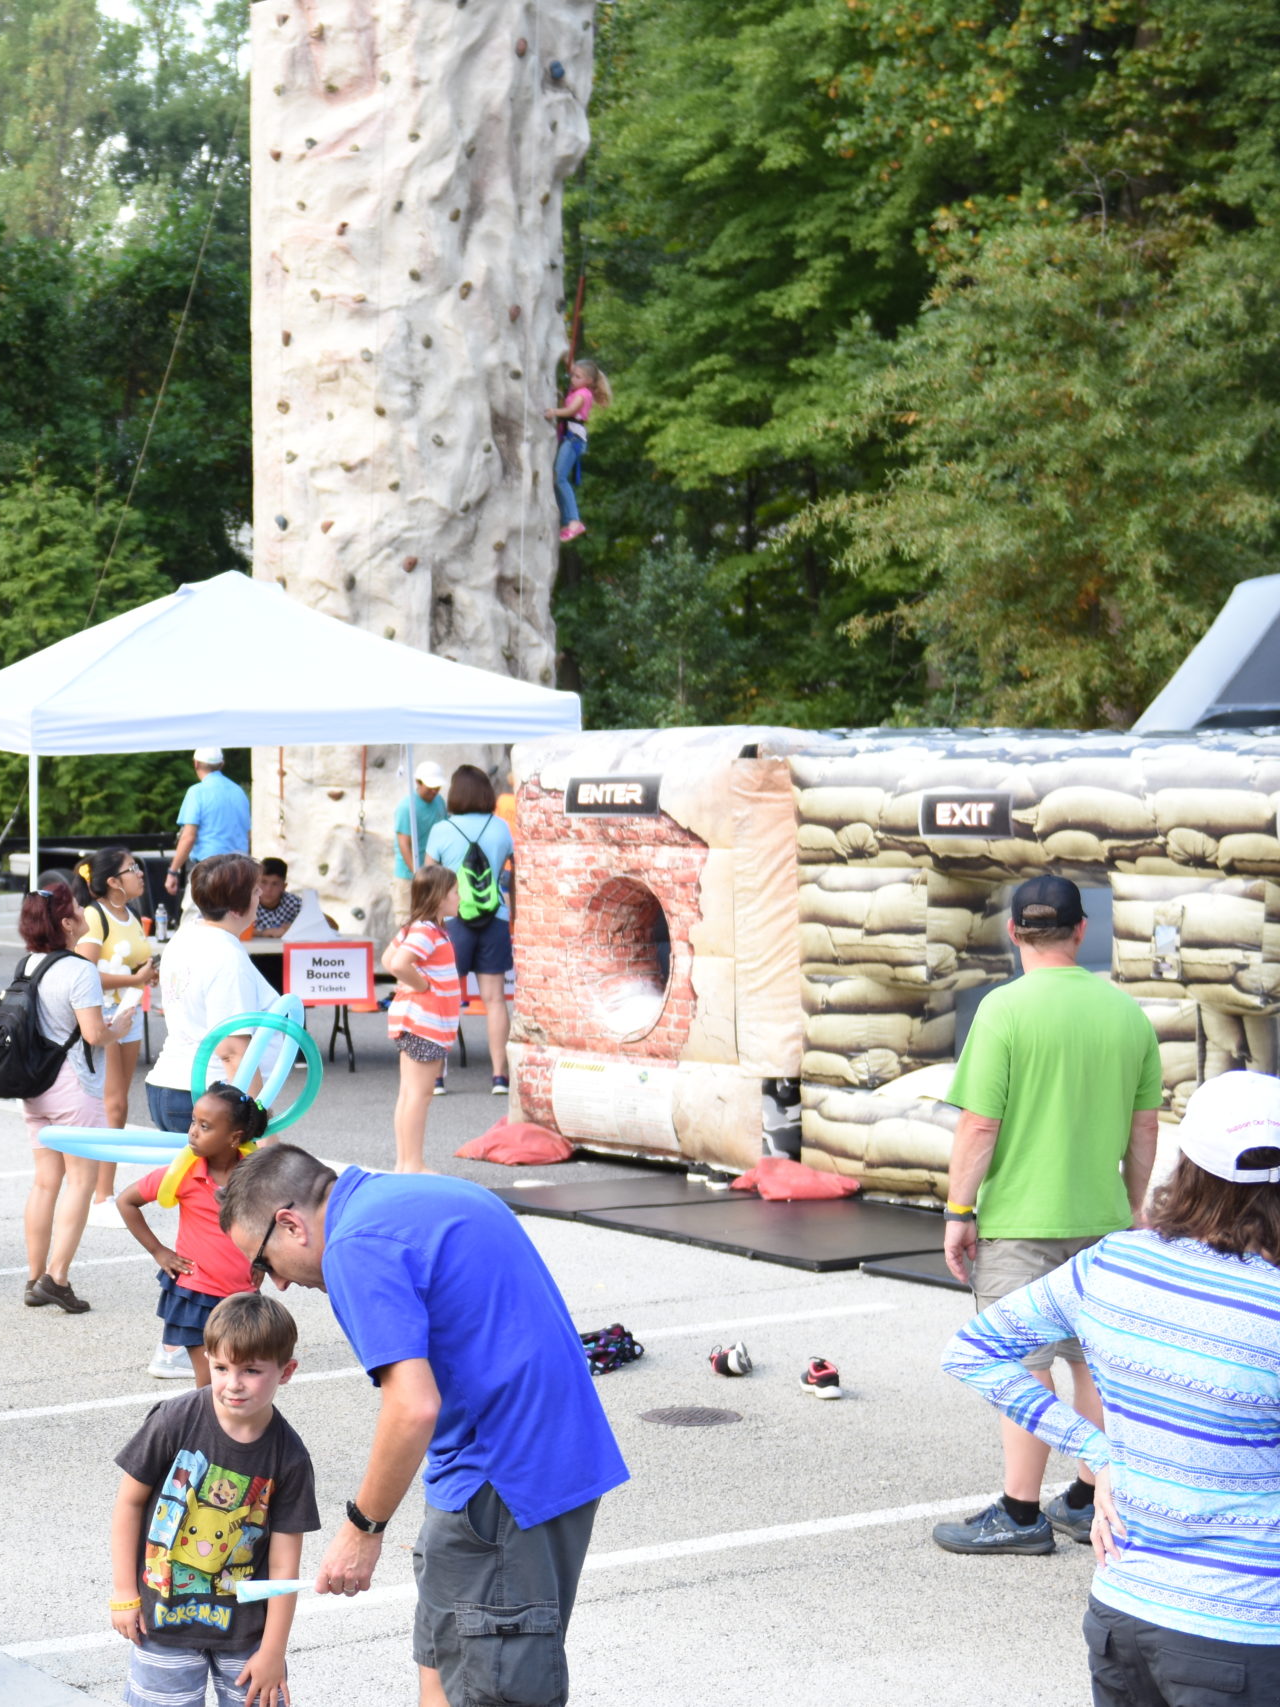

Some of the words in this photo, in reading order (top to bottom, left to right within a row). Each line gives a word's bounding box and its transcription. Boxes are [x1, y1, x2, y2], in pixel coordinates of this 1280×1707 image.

[577, 783, 643, 805] ENTER
[936, 802, 994, 826] EXIT
[312, 957, 345, 967] Moon
[306, 969, 351, 980] Bounce
[318, 985, 346, 993] Tickets
